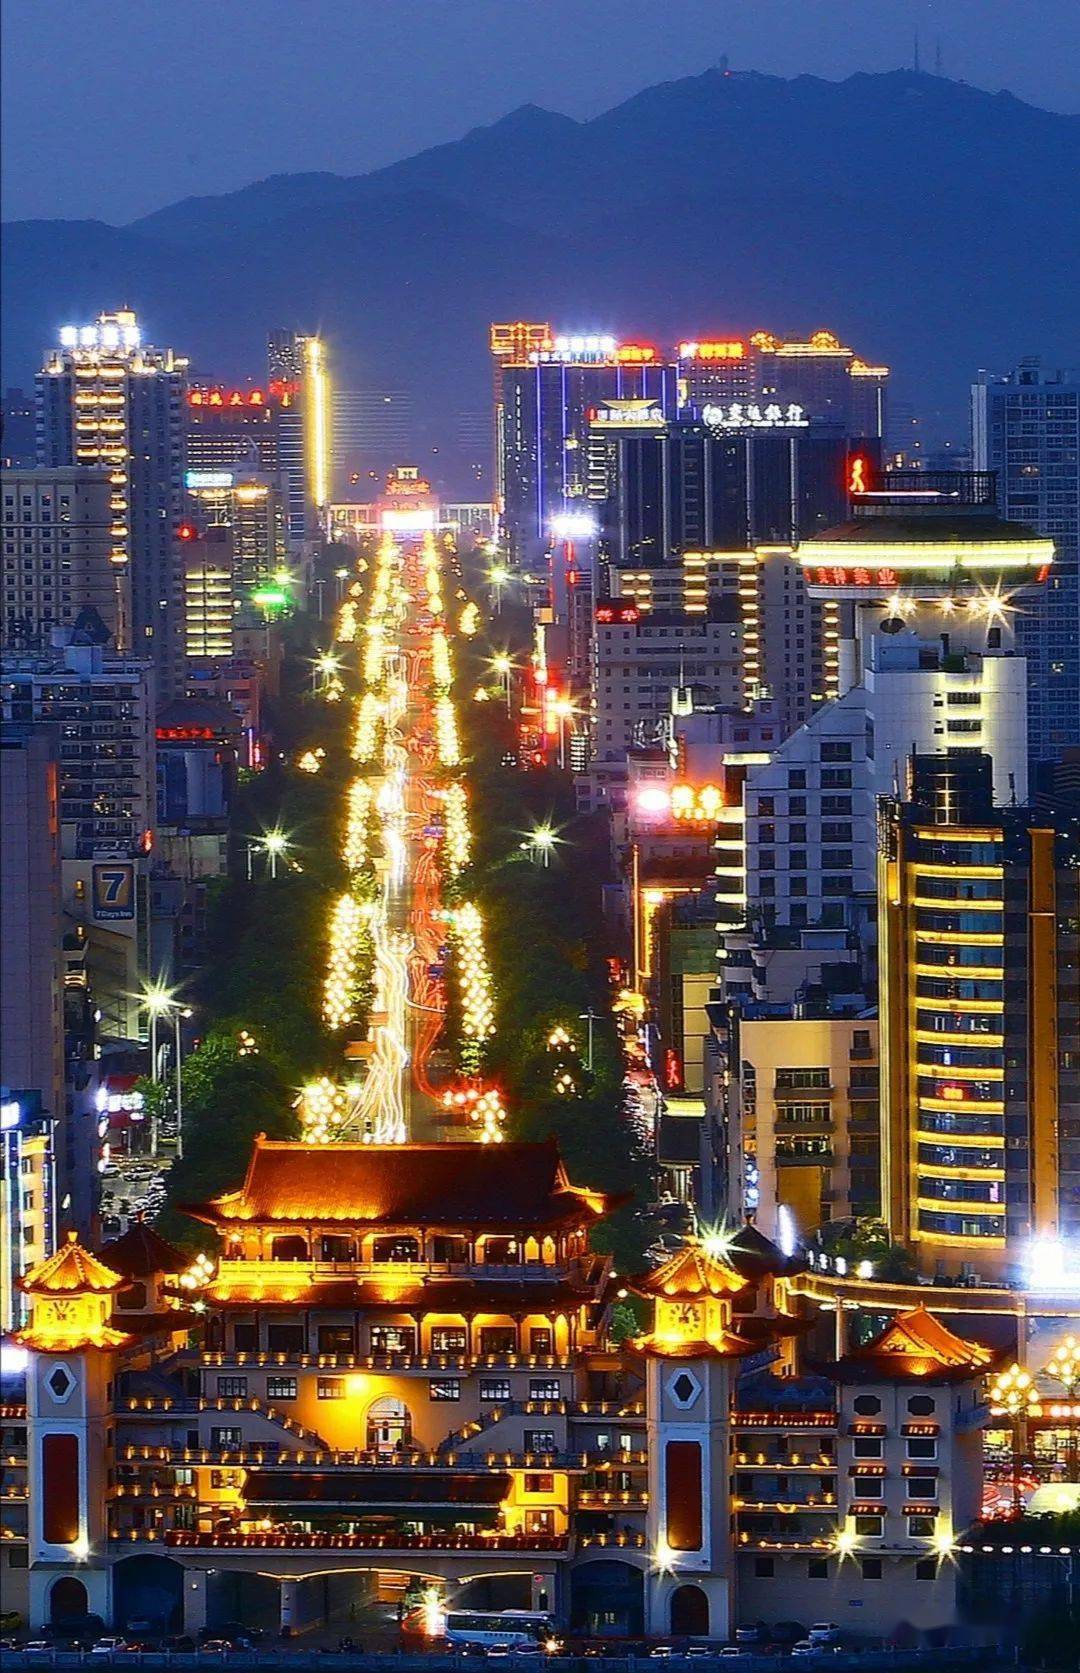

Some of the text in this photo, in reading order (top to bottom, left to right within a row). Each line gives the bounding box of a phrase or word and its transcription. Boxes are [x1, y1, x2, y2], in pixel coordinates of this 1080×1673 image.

[728, 402, 803, 421] 交通银行
[100, 871, 126, 903] 7
